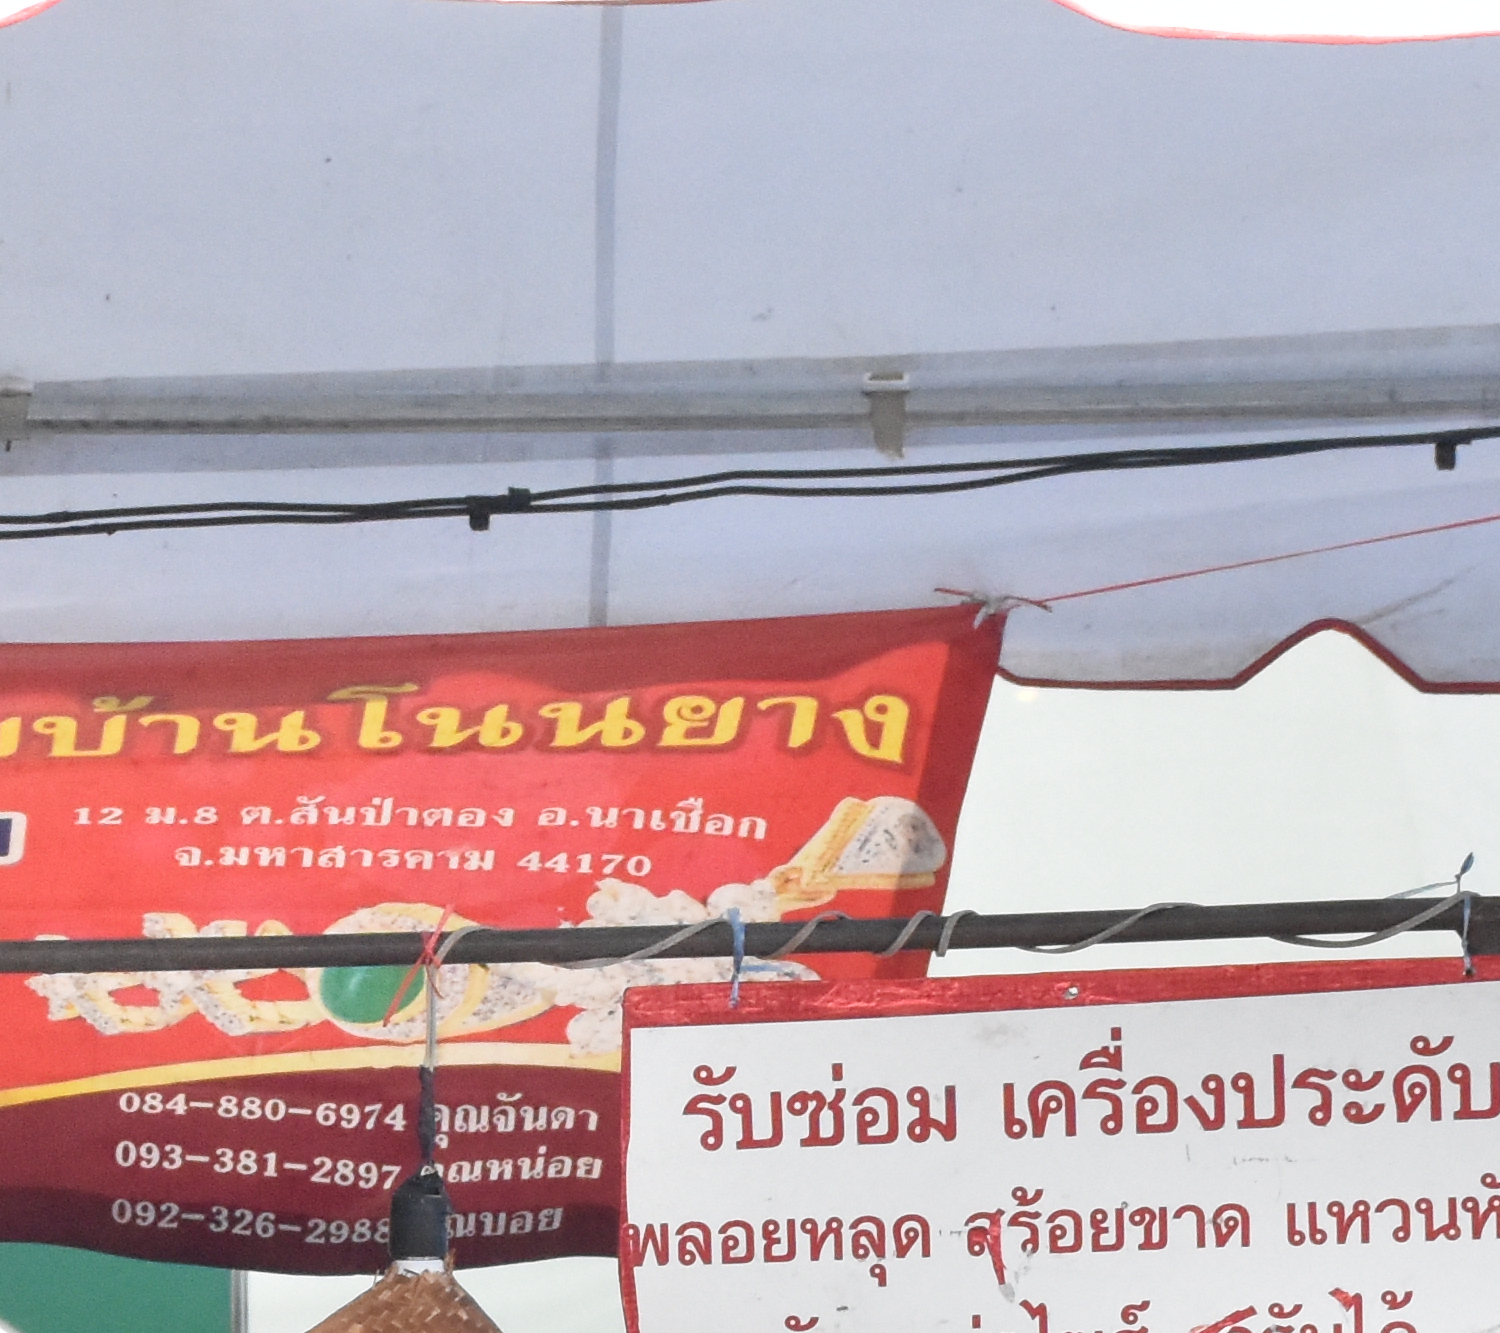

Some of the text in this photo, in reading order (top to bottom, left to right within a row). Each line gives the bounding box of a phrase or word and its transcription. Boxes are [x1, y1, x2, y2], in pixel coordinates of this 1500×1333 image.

[73, 795, 768, 840] 12 ม.8 ต.สันป่าตอง อ.นาเชือก
[174, 845, 653, 877] จ.มหาสารคาม 44170
[119, 1092, 407, 1132] 084-880-6974
[683, 1063, 958, 1152] รับซ่อม
[115, 1140, 403, 1190] 093-381-2897
[627, 1213, 932, 1288] พลอยหลุด
[964, 1186, 1251, 1278] สร้อยขาด
